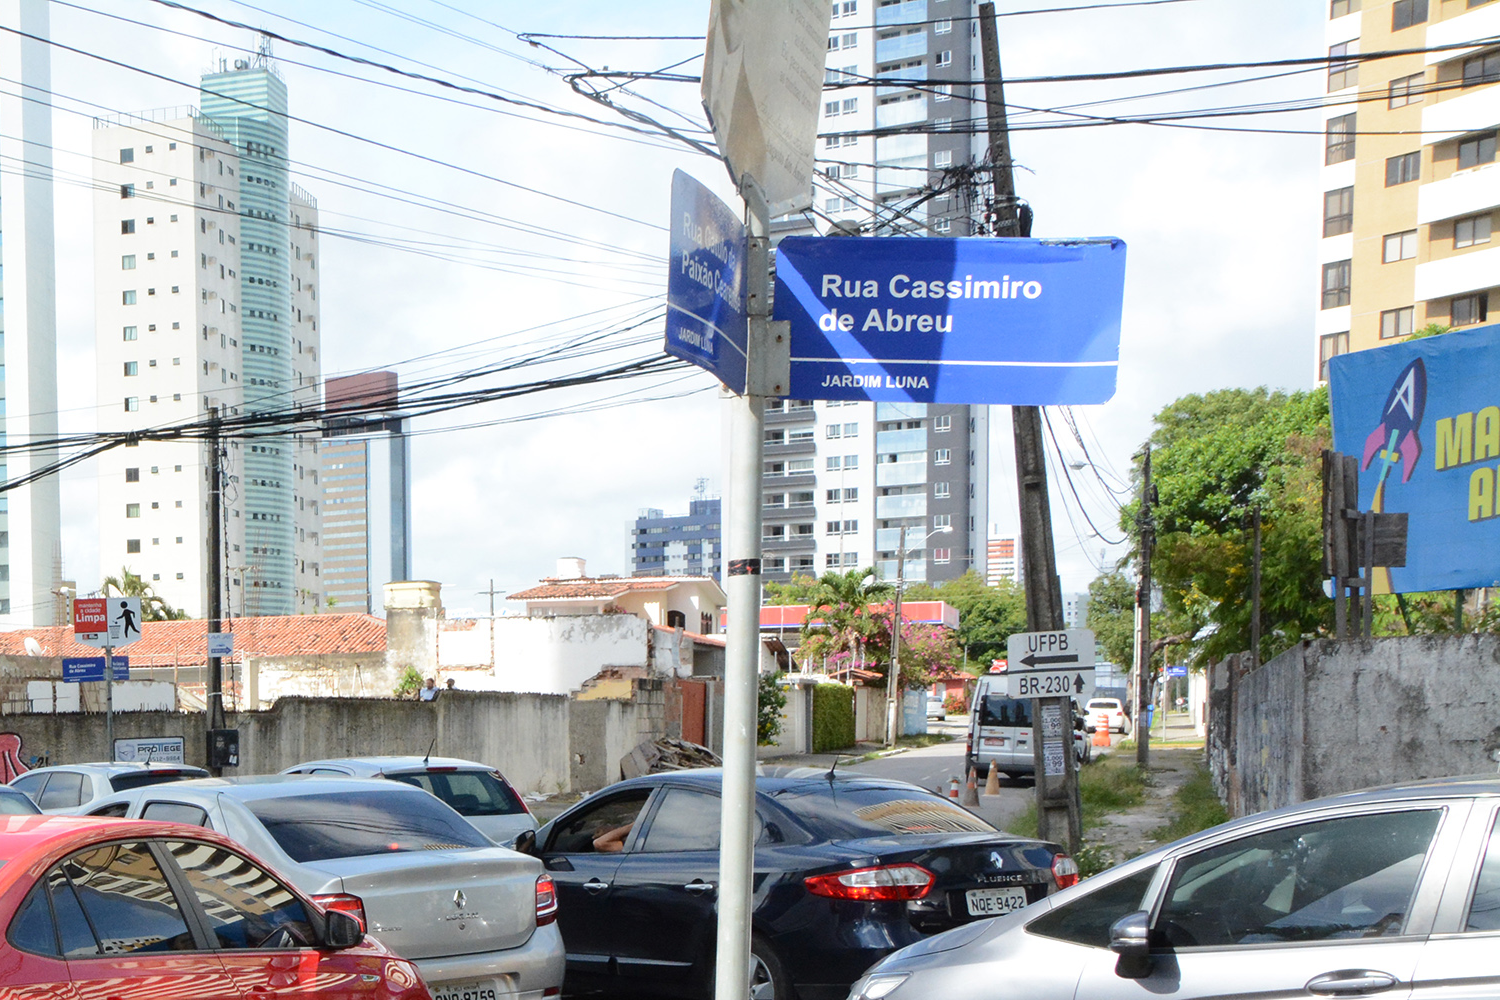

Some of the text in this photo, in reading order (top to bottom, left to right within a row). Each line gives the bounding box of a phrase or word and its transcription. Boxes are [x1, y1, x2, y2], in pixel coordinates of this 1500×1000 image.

[682, 211, 701, 245] Rua
[705, 225, 728, 264] Catulo
[681, 250, 713, 289] Paixão
[821, 274, 1042, 299] Rua Cassimiro
[818, 308, 953, 333] de Abreu
[678, 326, 701, 348] JARDIM
[821, 375, 929, 389] JARDIM LUNA
[75, 613, 106, 624] Limpa
[1028, 633, 1069, 653] UFPB
[1019, 675, 1070, 695] BR-230
[977, 874, 1023, 883] FLUENCE
